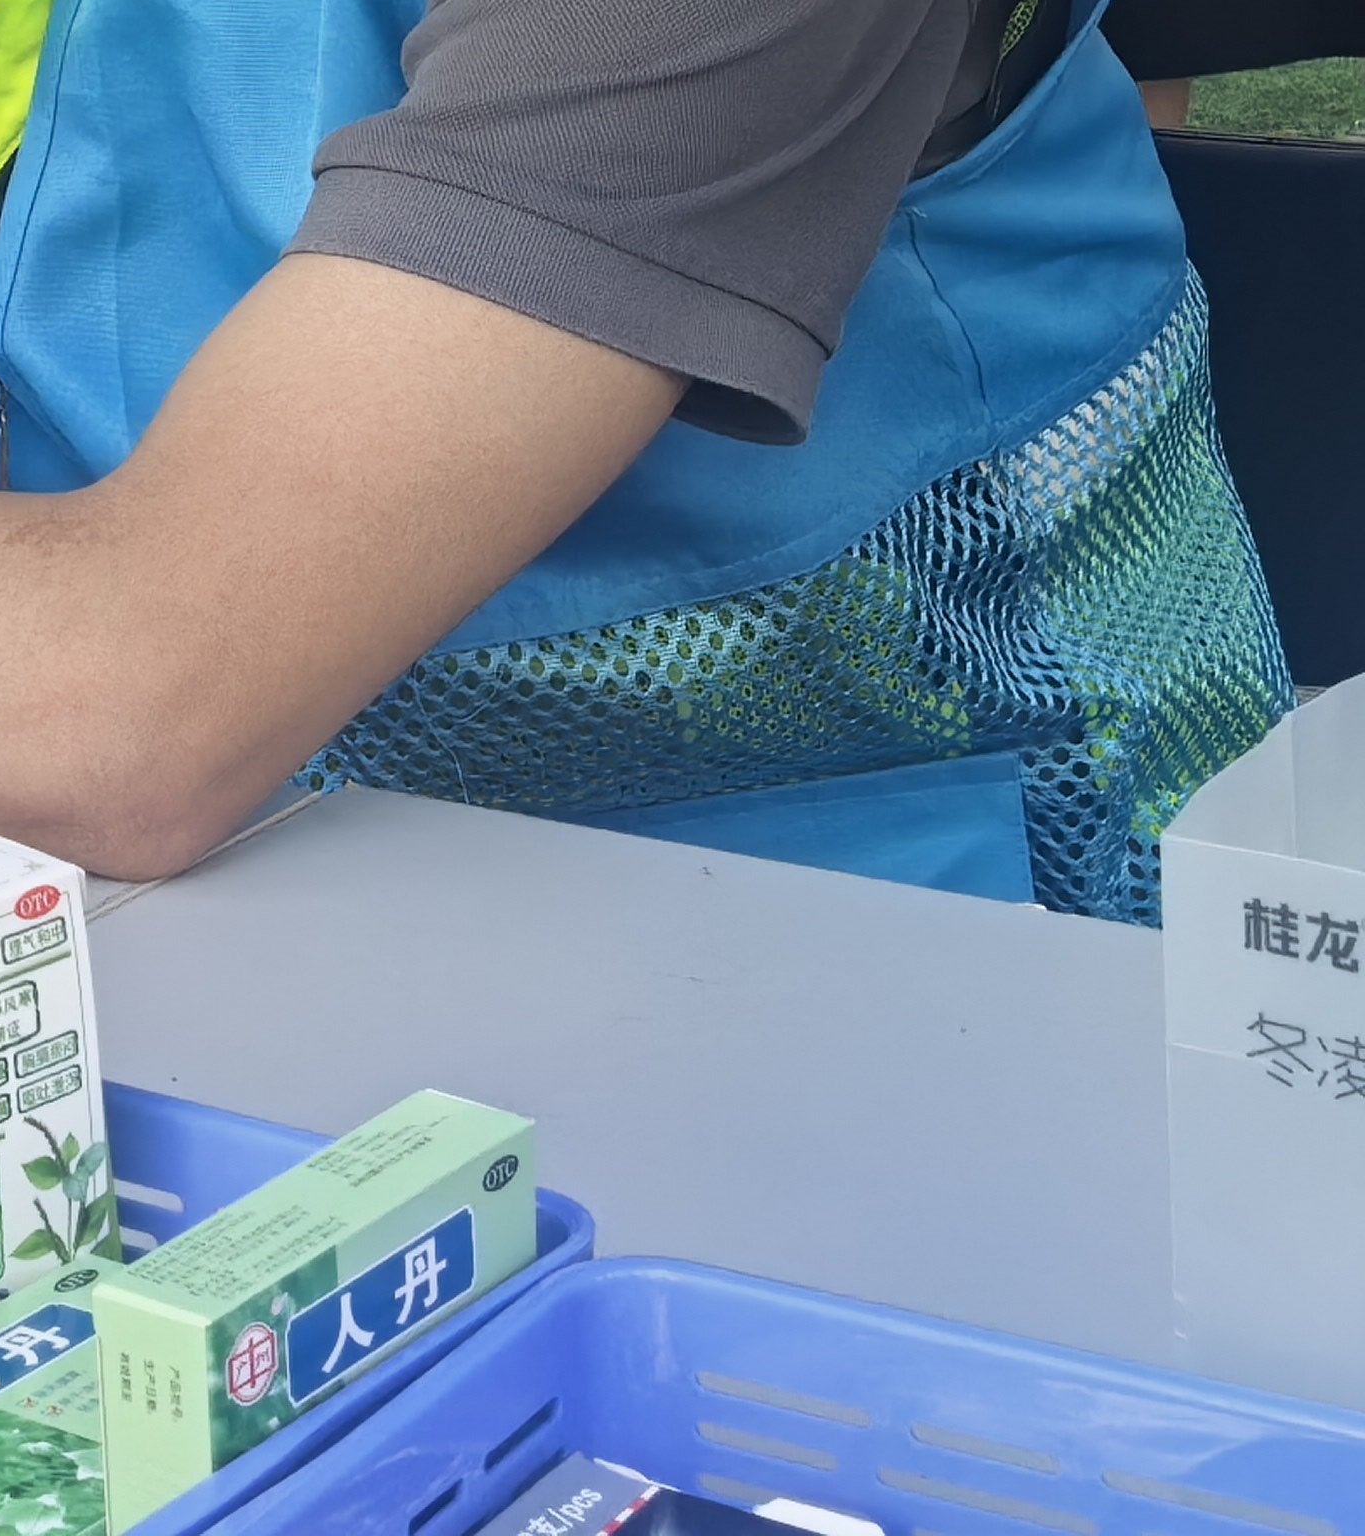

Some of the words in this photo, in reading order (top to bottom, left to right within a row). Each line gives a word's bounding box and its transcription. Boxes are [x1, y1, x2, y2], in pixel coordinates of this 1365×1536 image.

[18, 887, 59, 915] OTC
[9, 923, 67, 959] 理气和中
[1243, 897, 1360, 973] 桂龙
[485, 1156, 516, 1191] OTC
[321, 1236, 448, 1374] 人丹
